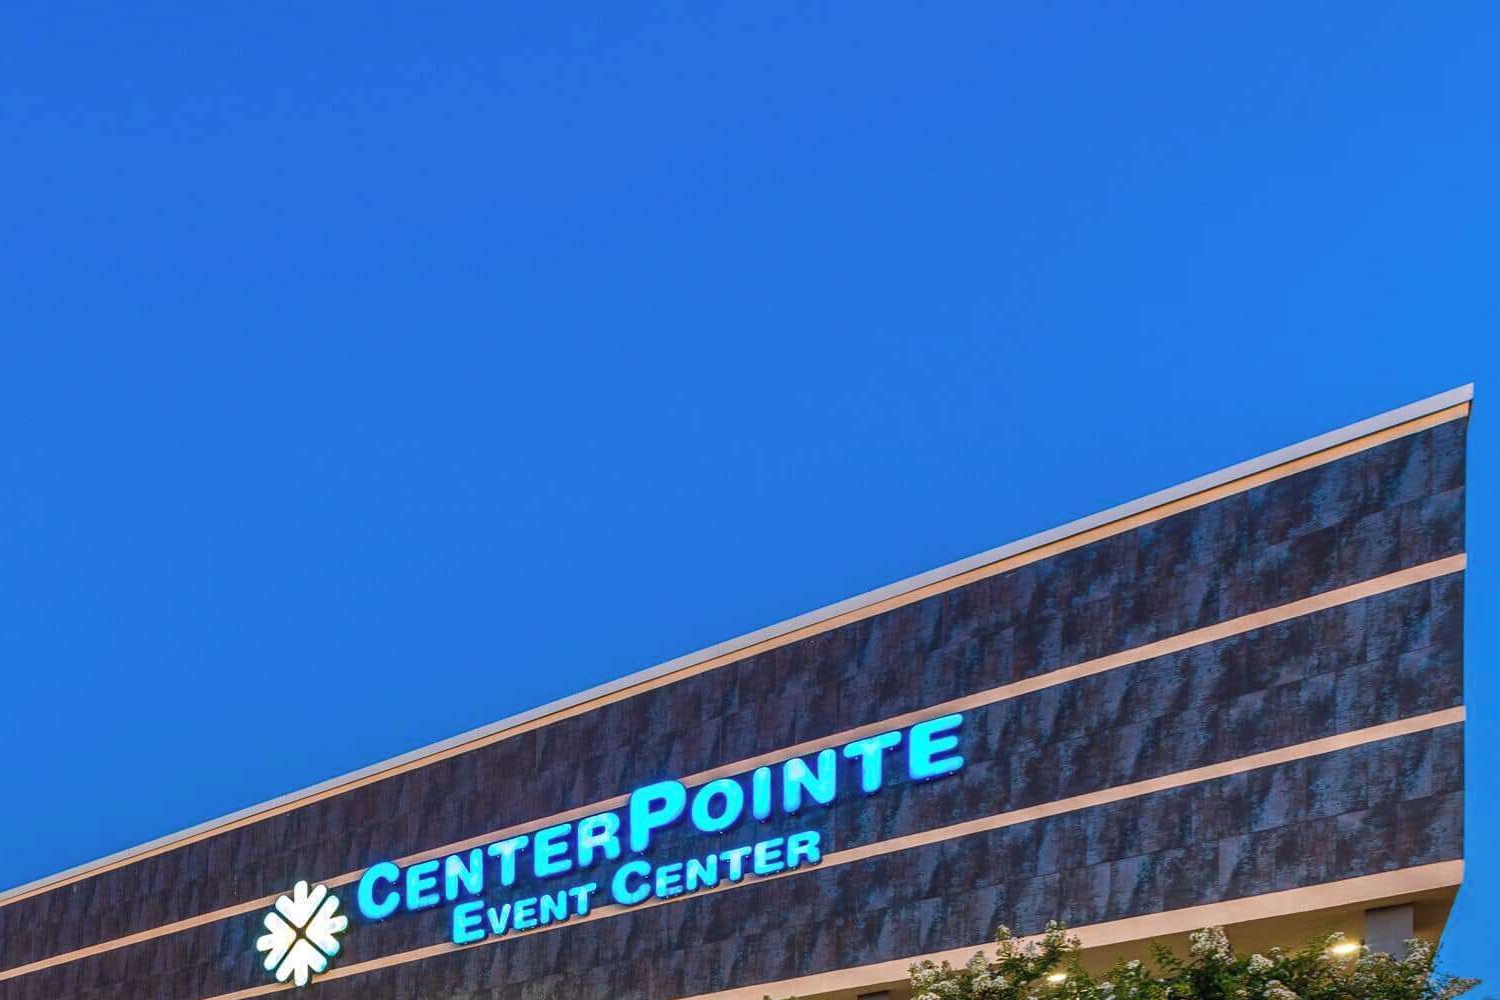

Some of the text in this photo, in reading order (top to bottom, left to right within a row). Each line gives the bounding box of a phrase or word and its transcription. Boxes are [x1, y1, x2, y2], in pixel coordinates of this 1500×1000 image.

[357, 713, 966, 920] CENTERPOINTE
[452, 830, 822, 945] EVENT CENTER
